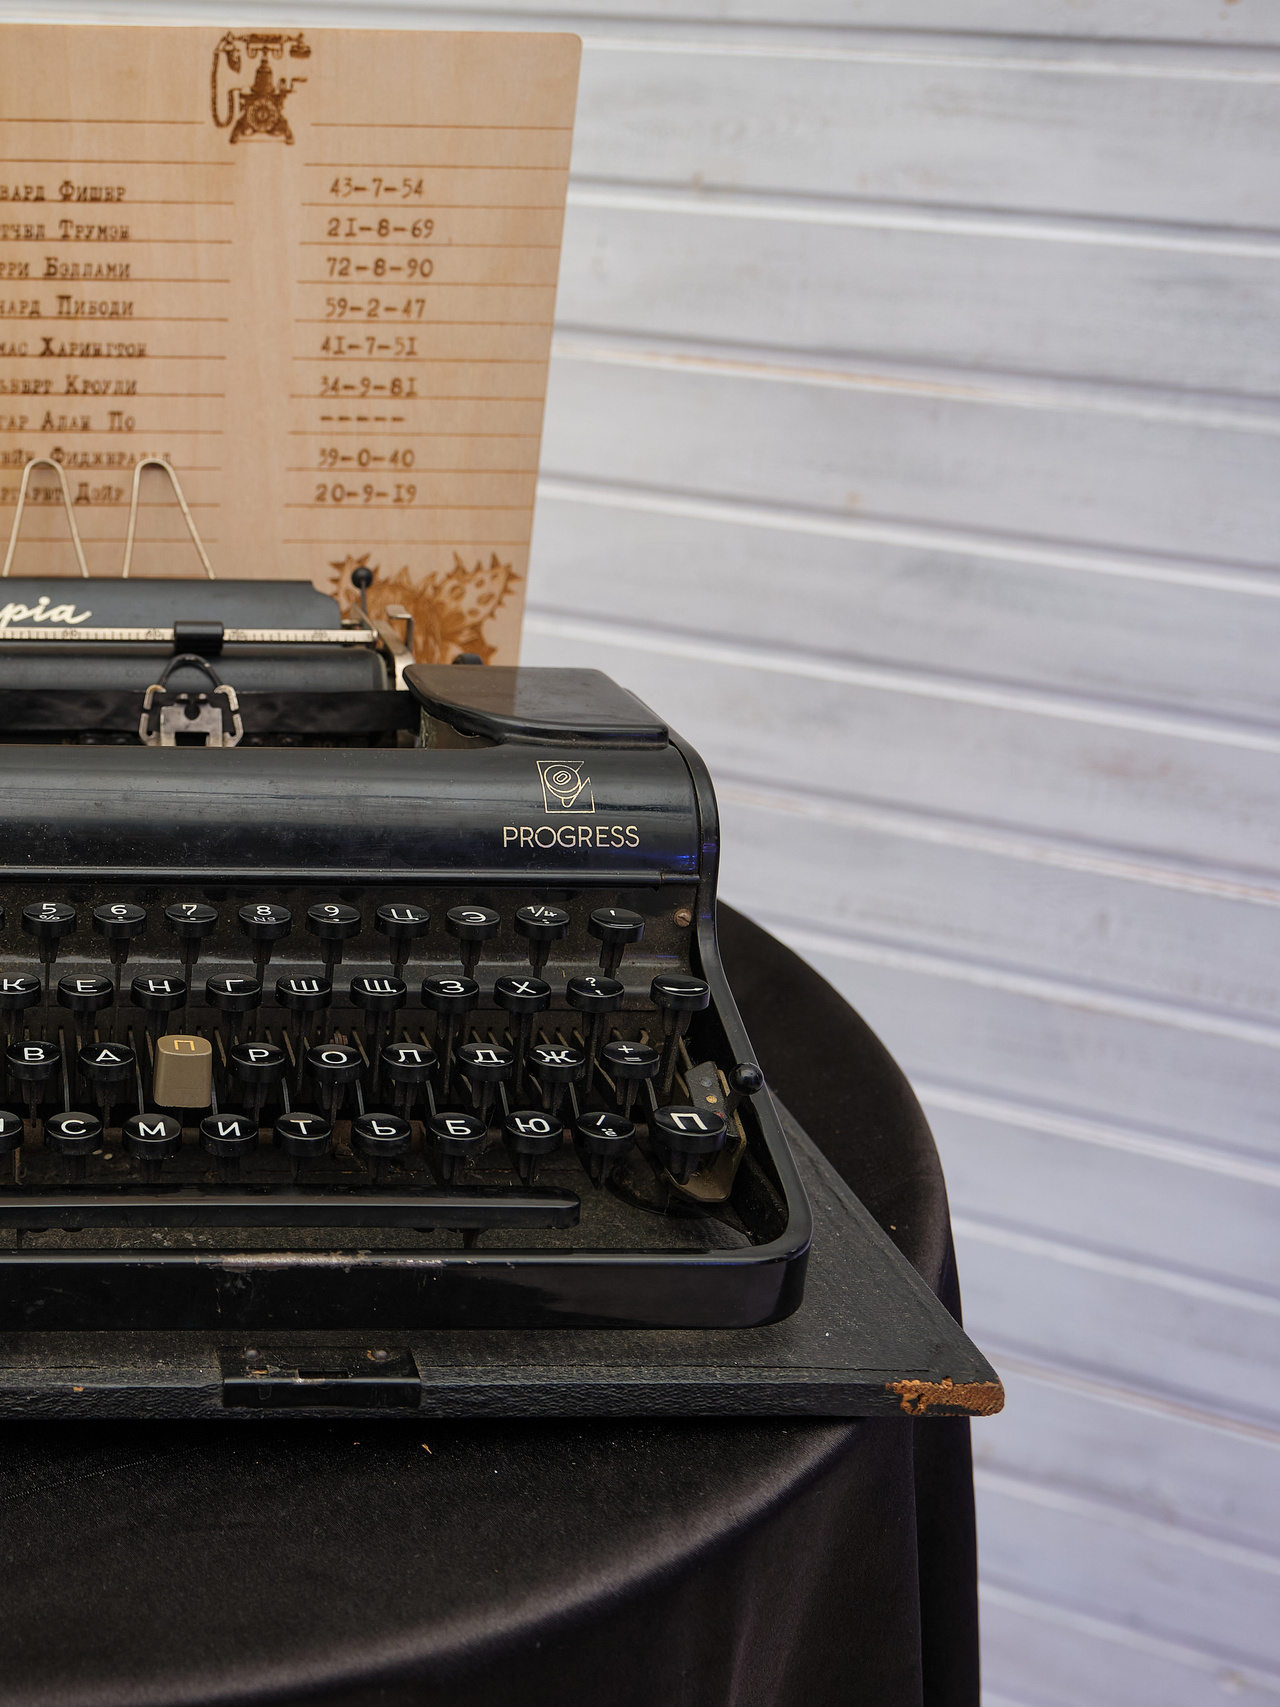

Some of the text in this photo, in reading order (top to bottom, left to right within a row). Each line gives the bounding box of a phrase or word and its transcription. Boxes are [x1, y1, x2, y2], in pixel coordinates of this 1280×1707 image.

[329, 177, 424, 198] 43-7-54
[326, 257, 434, 278] 72-8-90
[325, 298, 426, 318] 59-2-47
[318, 448, 415, 468] 39-0-40
[503, 825, 640, 848] PROGRESS
[41, 903, 57, 915] 5
[111, 905, 127, 915] 6
[182, 904, 197, 916] 7
[255, 905, 272, 916] 8
[324, 905, 340, 917] 9
[462, 911, 487, 923] Э
[3, 978, 26, 991] К
[76, 979, 98, 993] Е
[148, 979, 171, 992] Н
[224, 979, 244, 992] Г
[289, 979, 319, 992] Ш
[363, 979, 397, 993] Щ
[511, 981, 537, 994] Х
[23, 1047, 45, 1061] В
[95, 1049, 122, 1062] А
[173, 1039, 196, 1051] П
[248, 1049, 270, 1062] Р
[321, 1051, 348, 1064] О
[397, 1049, 422, 1063] Л
[473, 1049, 506, 1064] Д
[536, 1049, 577, 1064] Ж
[60, 1119, 87, 1135] С
[138, 1121, 166, 1137] М
[217, 1121, 241, 1137] И
[289, 1119, 313, 1135] Т
[371, 1120, 397, 1135] Ь
[445, 1119, 472, 1135] Б
[515, 1117, 551, 1133] Ю
[670, 1112, 708, 1131] П
